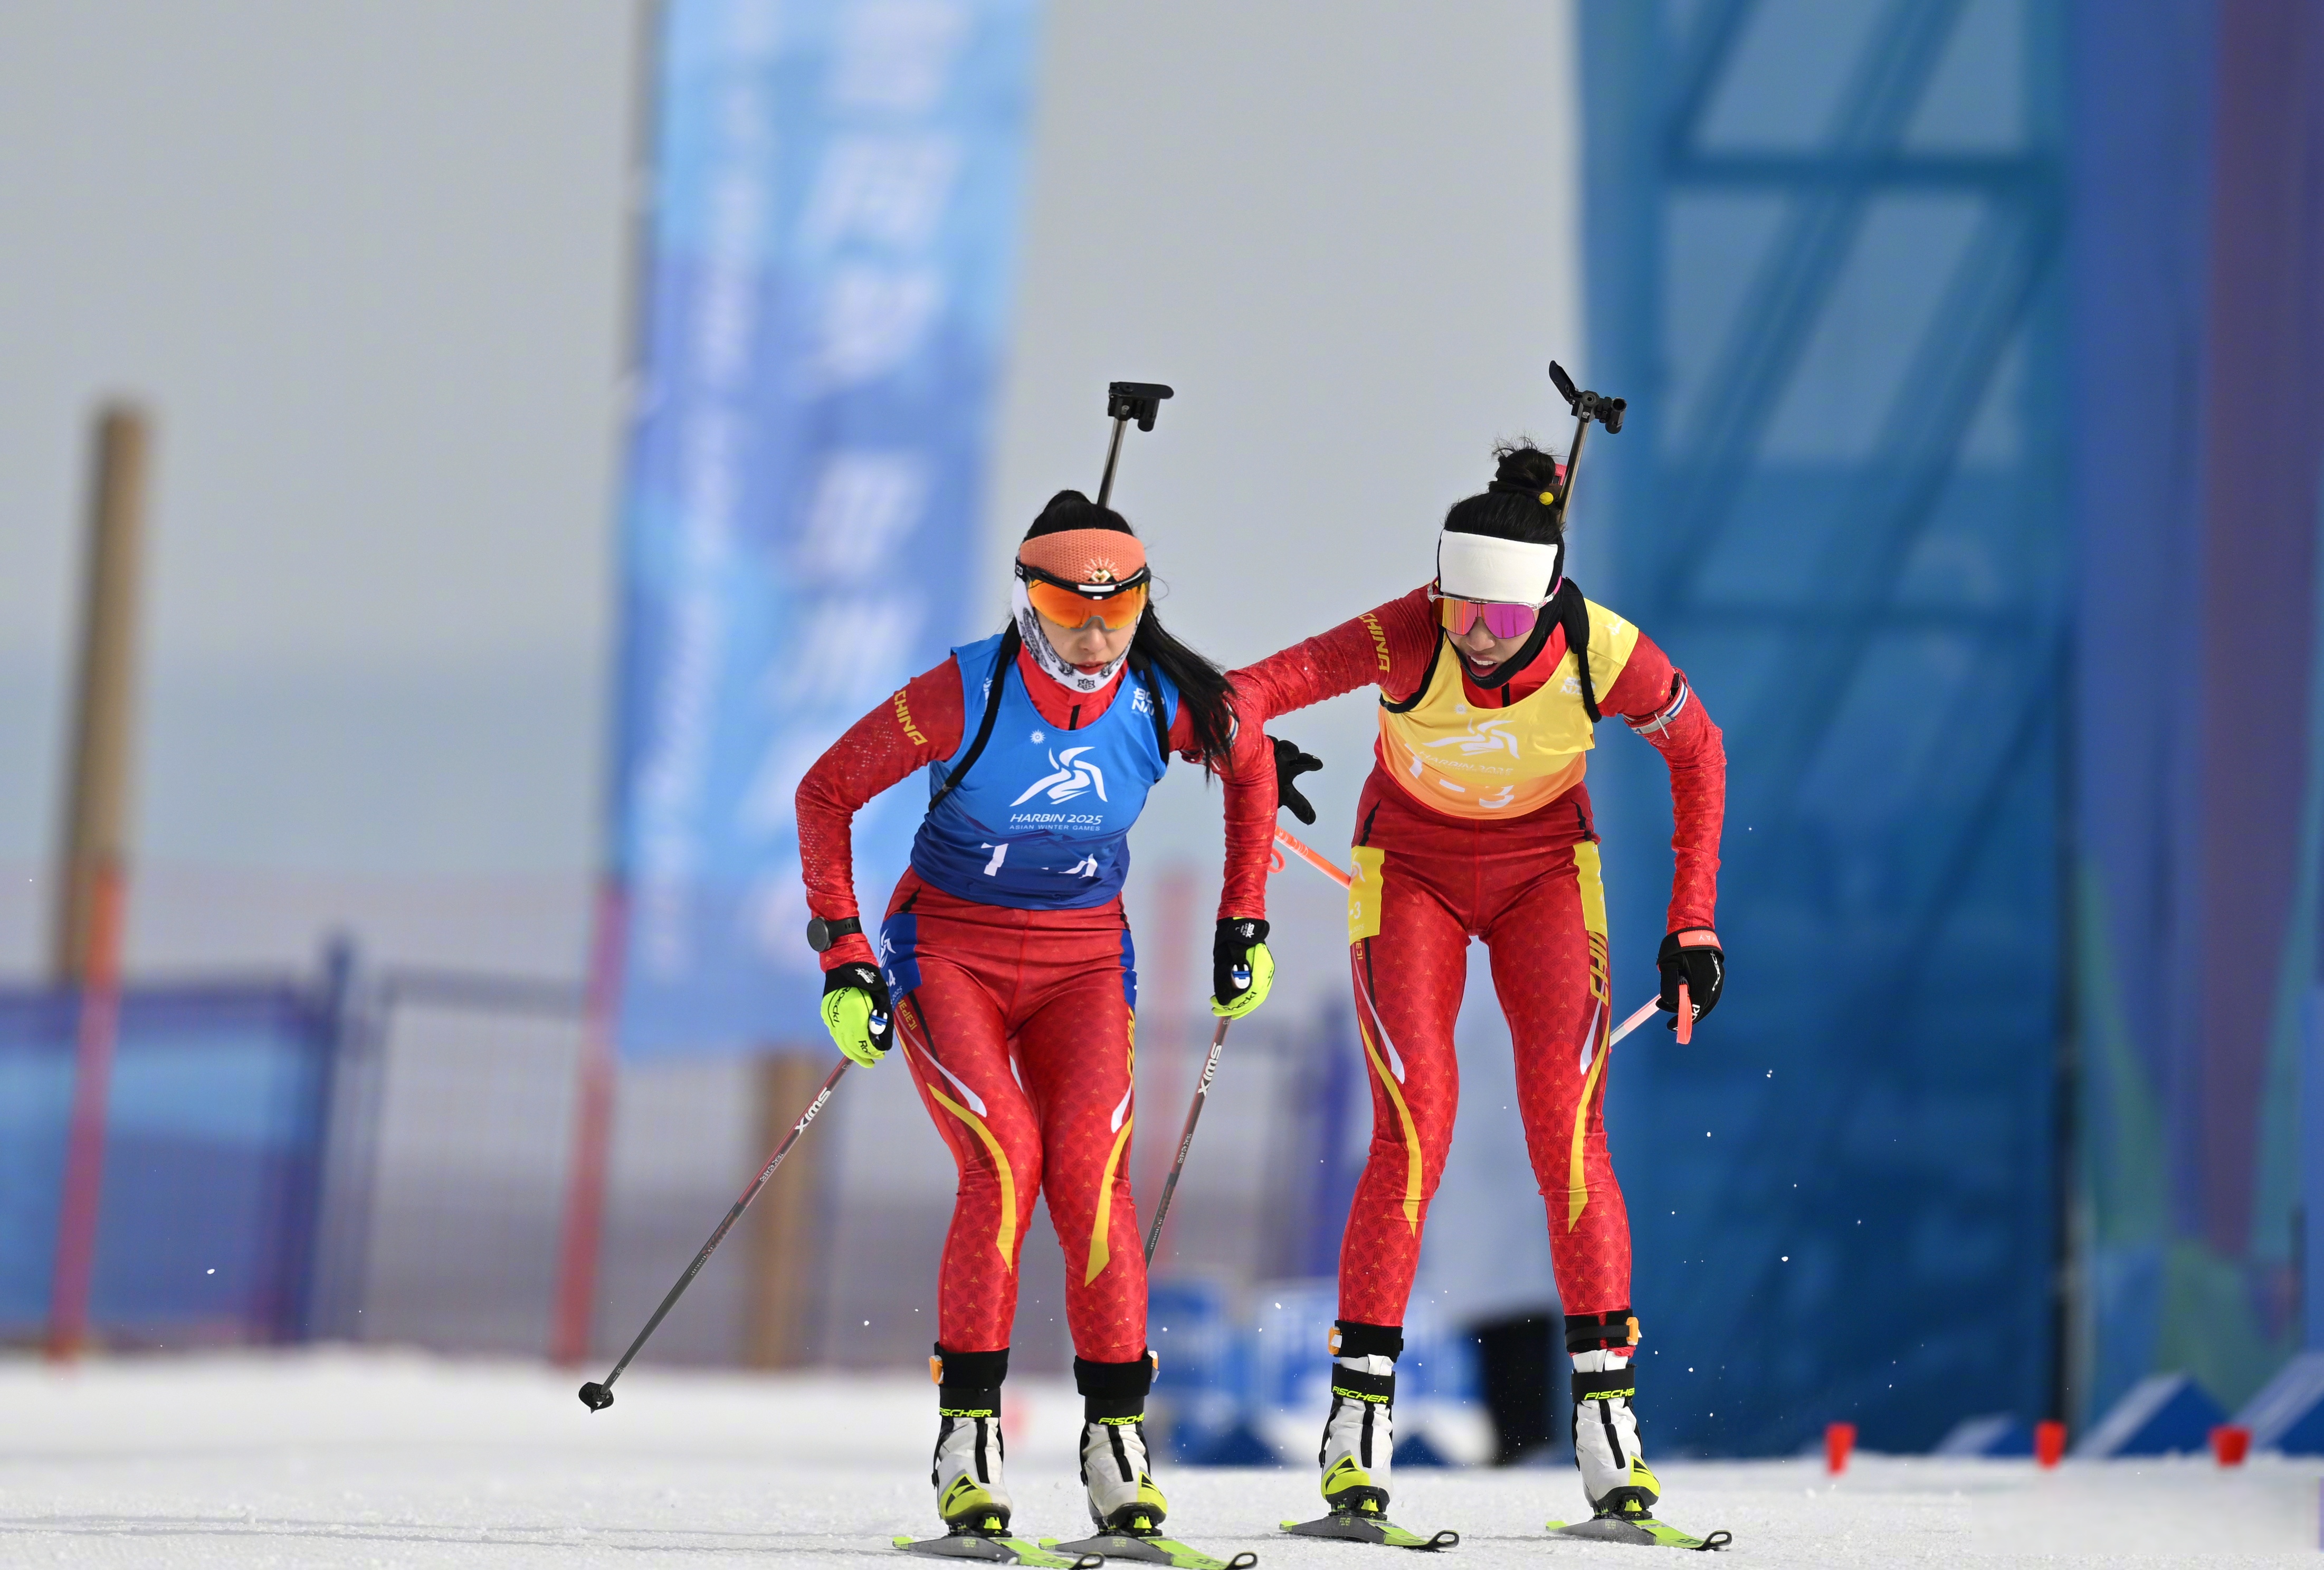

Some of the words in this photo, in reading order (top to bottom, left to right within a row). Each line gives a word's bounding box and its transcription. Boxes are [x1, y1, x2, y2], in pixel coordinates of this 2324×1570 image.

[1357, 613, 1390, 673] CHINA
[894, 690, 928, 746] CHINA
[1009, 813, 1066, 823] HARBIN
[1066, 814, 1103, 825] 2025
[898, 999, 918, 1031] ICEPE
[1197, 1042, 1222, 1097] SWIX
[794, 1087, 832, 1135] SWIX
[1332, 1385, 1389, 1404] FISCHER
[1098, 1412, 1145, 1425] FISCHE
